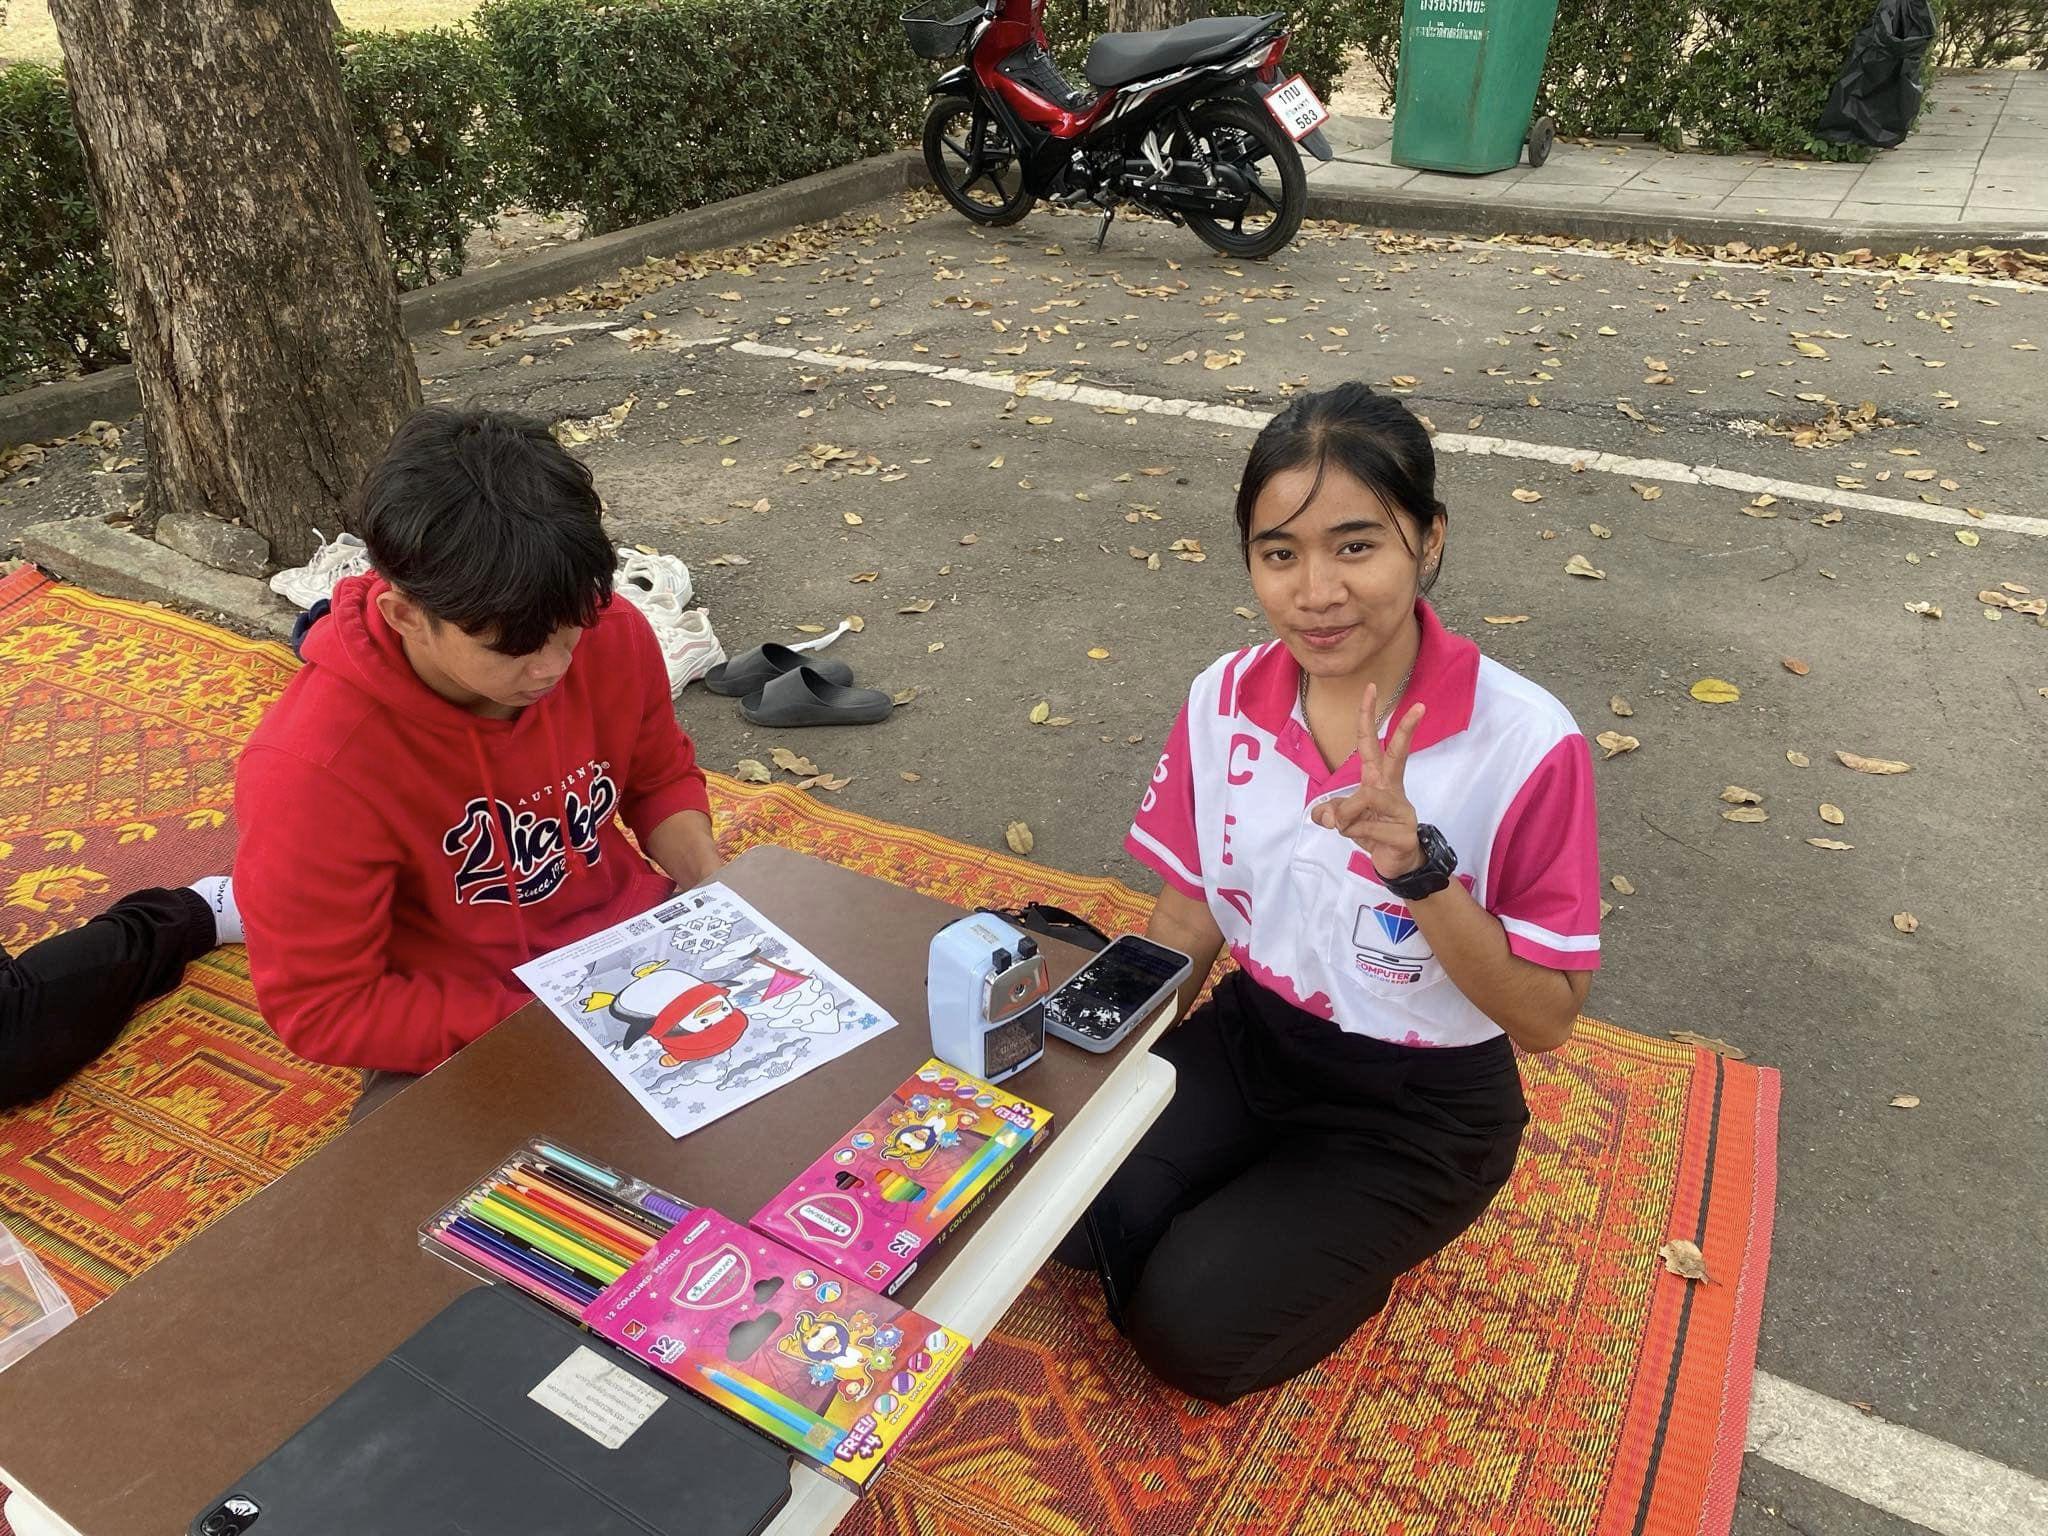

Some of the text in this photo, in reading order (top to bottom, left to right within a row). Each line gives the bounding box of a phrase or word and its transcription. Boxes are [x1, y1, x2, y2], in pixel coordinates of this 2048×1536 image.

[1296, 109, 1318, 129] 583
[1356, 960, 1410, 980] COMPUTER
[949, 1193, 986, 1233] COLOURED
[988, 1163, 1014, 1193] PENCILS
[890, 1239, 911, 1256] 12
[616, 1274, 653, 1310] COLOURED
[653, 1248, 681, 1275] PENCILS
[650, 1336, 675, 1355] 12
[838, 1415, 877, 1460] FREE!!
